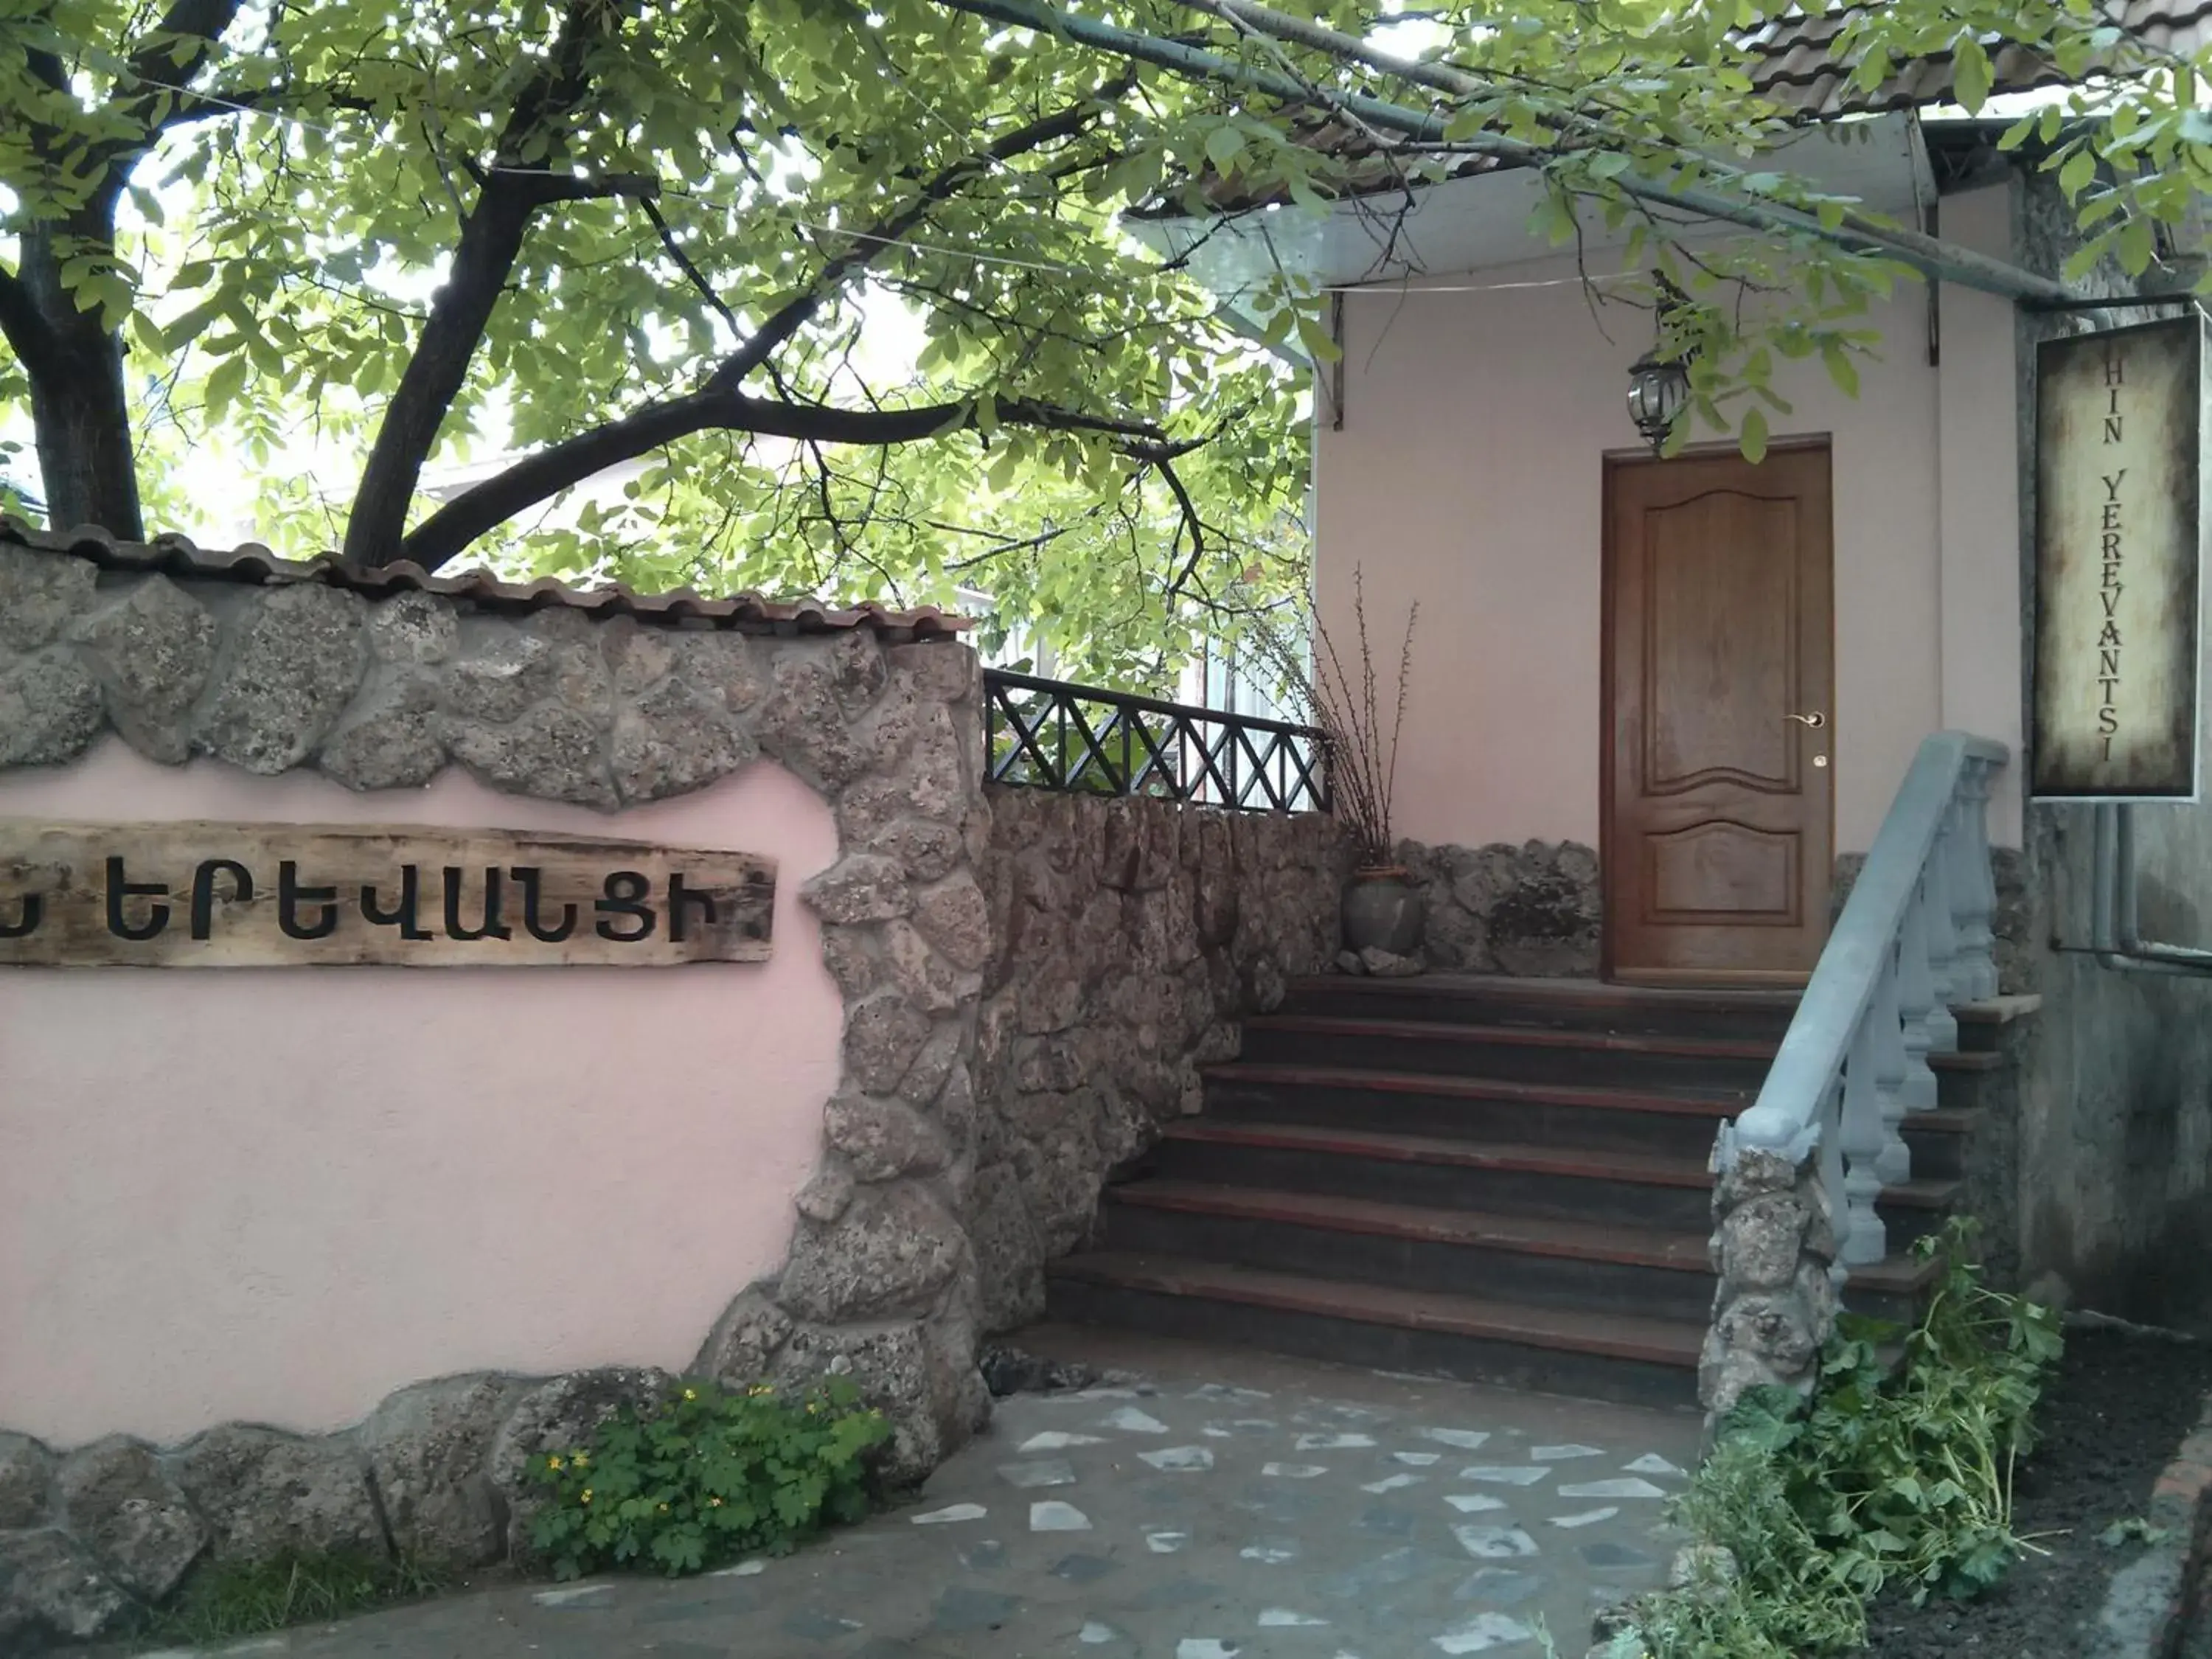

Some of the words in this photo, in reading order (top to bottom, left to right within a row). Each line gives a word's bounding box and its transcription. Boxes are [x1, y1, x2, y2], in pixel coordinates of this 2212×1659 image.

[2104, 358, 2124, 444] HIN
[2098, 468, 2127, 762] YEREVANTSI
[106, 855, 718, 943] ԵՐԵՎԱՆՑԻ
